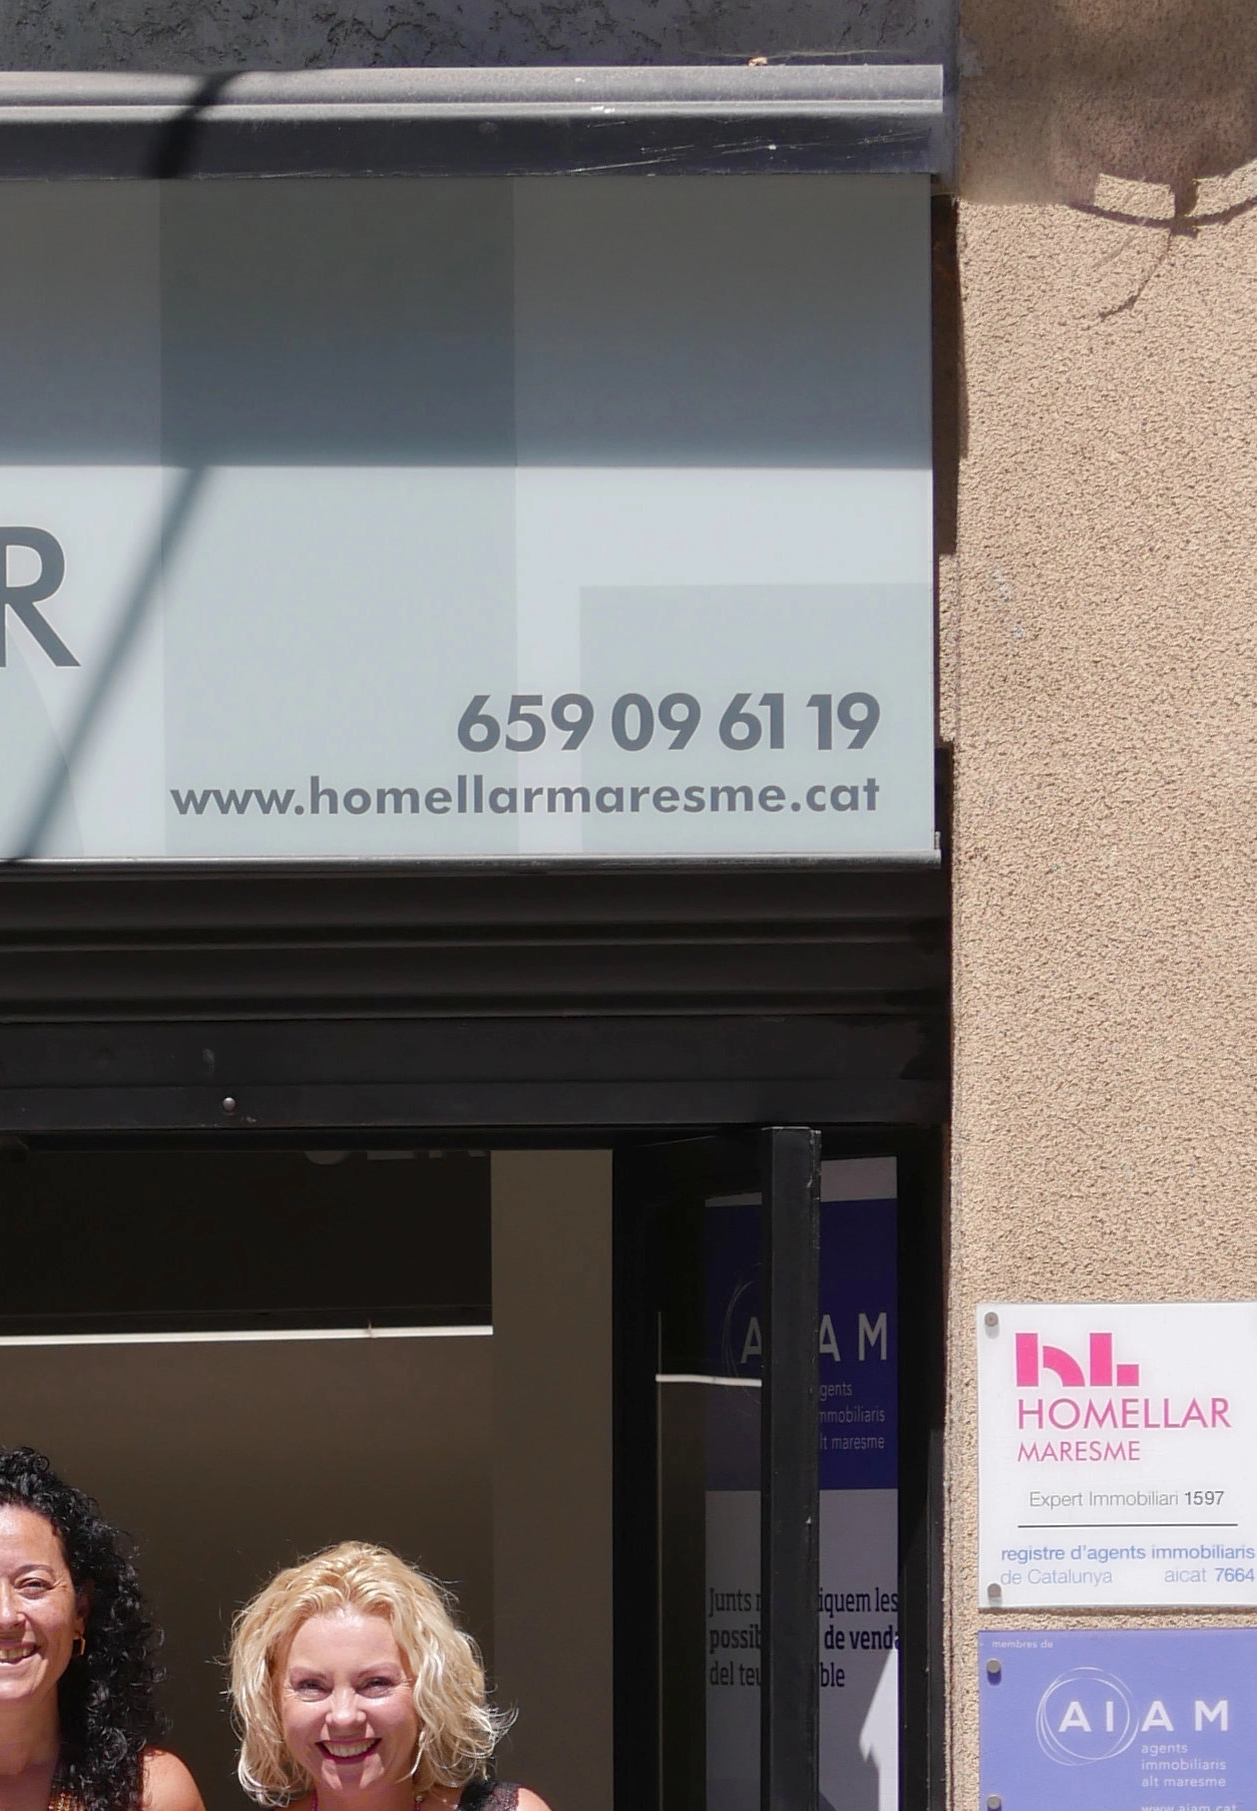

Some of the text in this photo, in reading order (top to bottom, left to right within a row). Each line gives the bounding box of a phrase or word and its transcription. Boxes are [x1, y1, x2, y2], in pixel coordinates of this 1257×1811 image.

[457, 692, 881, 754] 659 09 61 19
[169, 774, 880, 816] www.homellarmaresme.cat
[819, 1382, 854, 1402] gents
[819, 1404, 886, 1424] mmobiliaris
[1018, 1397, 1232, 1430] HOMELLAR
[831, 1435, 886, 1451] maresme
[1017, 1440, 1141, 1463] MARESME
[1029, 1490, 1225, 1509] Expert Immobiliari 1597
[1000, 1544, 1256, 1564] registre d'agents immobiliaris
[1000, 1567, 1256, 1588] de Catalunya aicat 7664
[708, 1587, 752, 1617] Junts
[824, 1624, 846, 1649] de
[991, 1639, 1054, 1649] membres de
[709, 1660, 734, 1686] del
[1141, 1743, 1189, 1757] agents
[1141, 1757, 1227, 1771] immobiliaris
[1141, 1775, 1227, 1788] alt maresme
